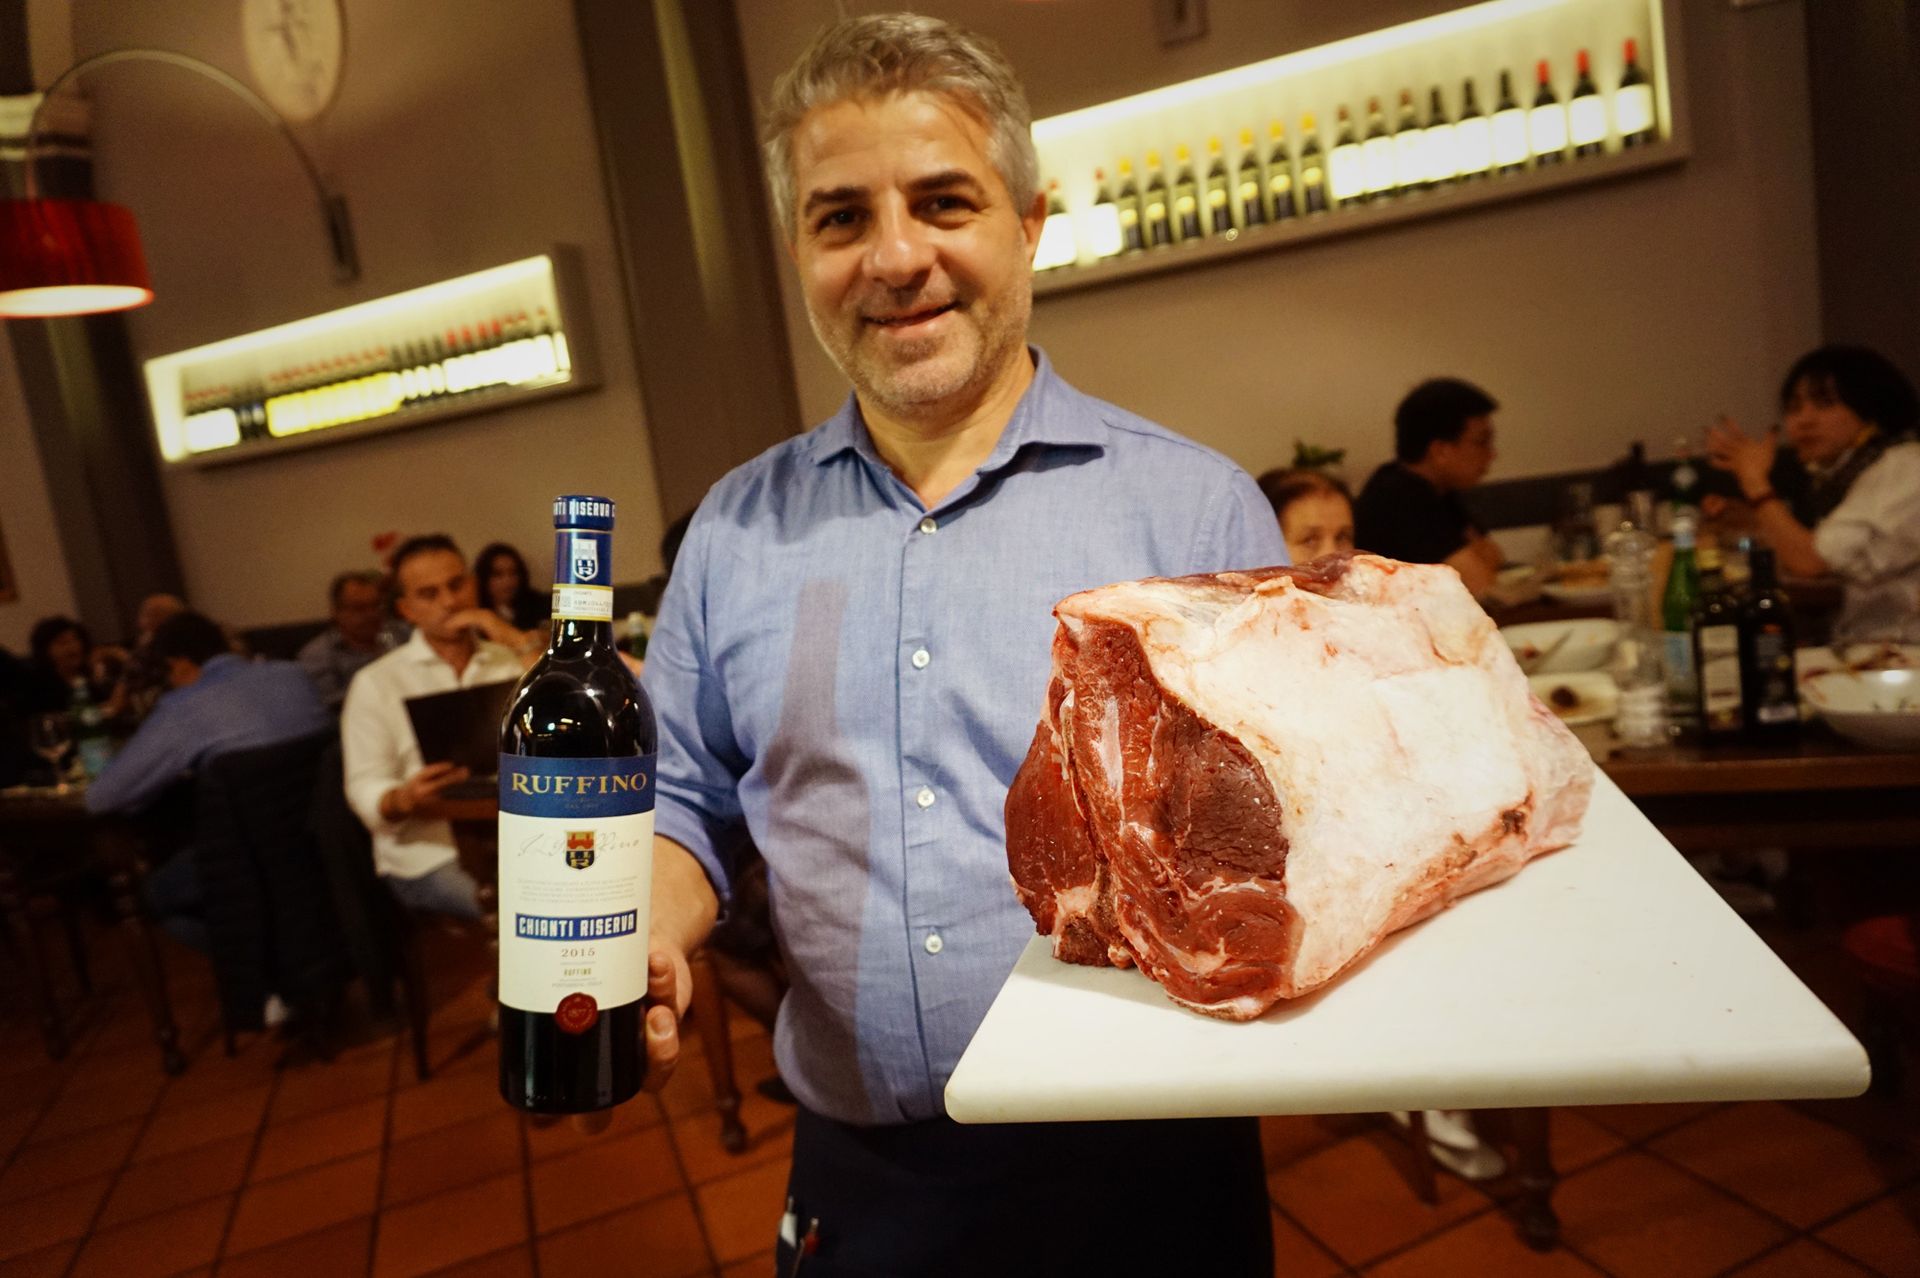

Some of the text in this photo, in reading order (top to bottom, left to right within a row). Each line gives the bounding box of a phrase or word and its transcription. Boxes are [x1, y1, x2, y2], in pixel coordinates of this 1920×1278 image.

[511, 772, 647, 795] RUFFINO
[518, 913, 635, 937] CHIANTI RISERVA
[561, 947, 596, 958] 2015
